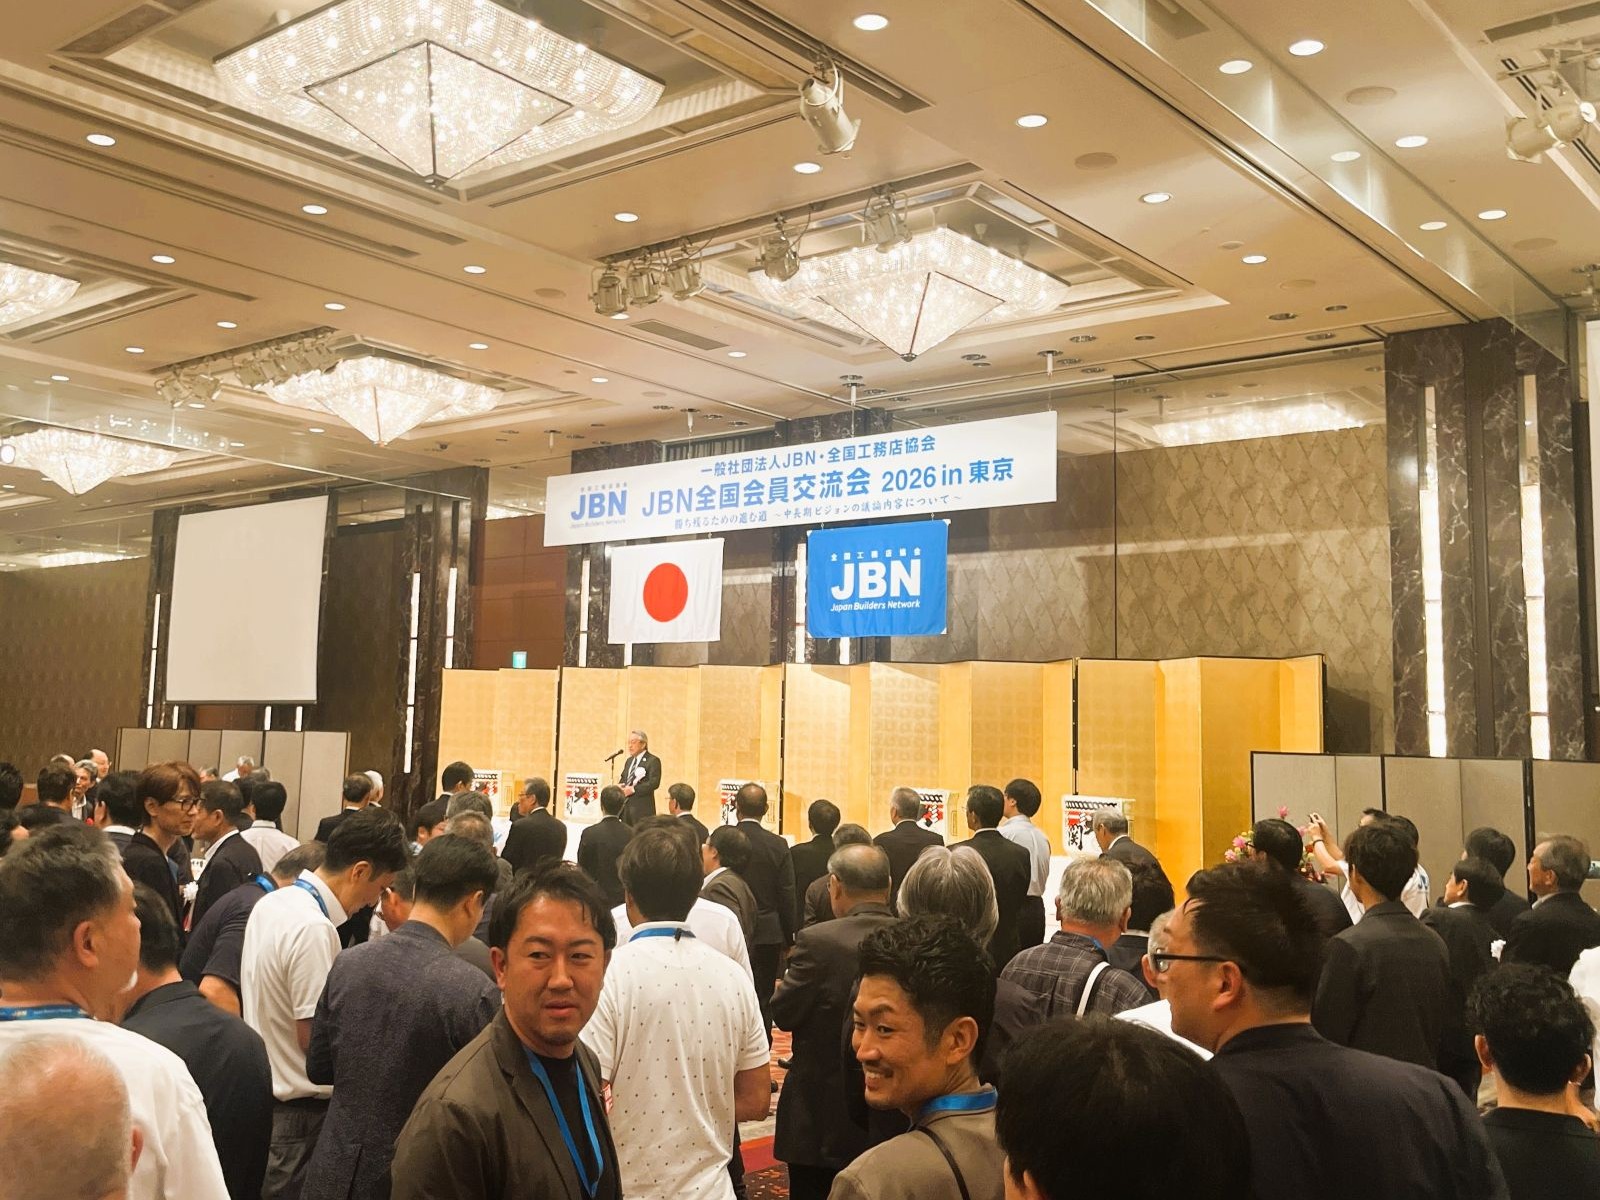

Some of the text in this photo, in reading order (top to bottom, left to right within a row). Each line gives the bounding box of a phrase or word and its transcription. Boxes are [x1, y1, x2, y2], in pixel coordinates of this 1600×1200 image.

[701, 434, 936, 477] 一般社団法人JBN・全国工務店協会
[570, 490, 627, 520] JBN
[642, 467, 871, 518] JBN全国会員交流会
[881, 466, 937, 493] 2026
[941, 464, 963, 486] in
[968, 457, 1014, 484] 東京
[830, 559, 921, 601] JBN
[830, 599, 921, 613] Japan Builders Network
